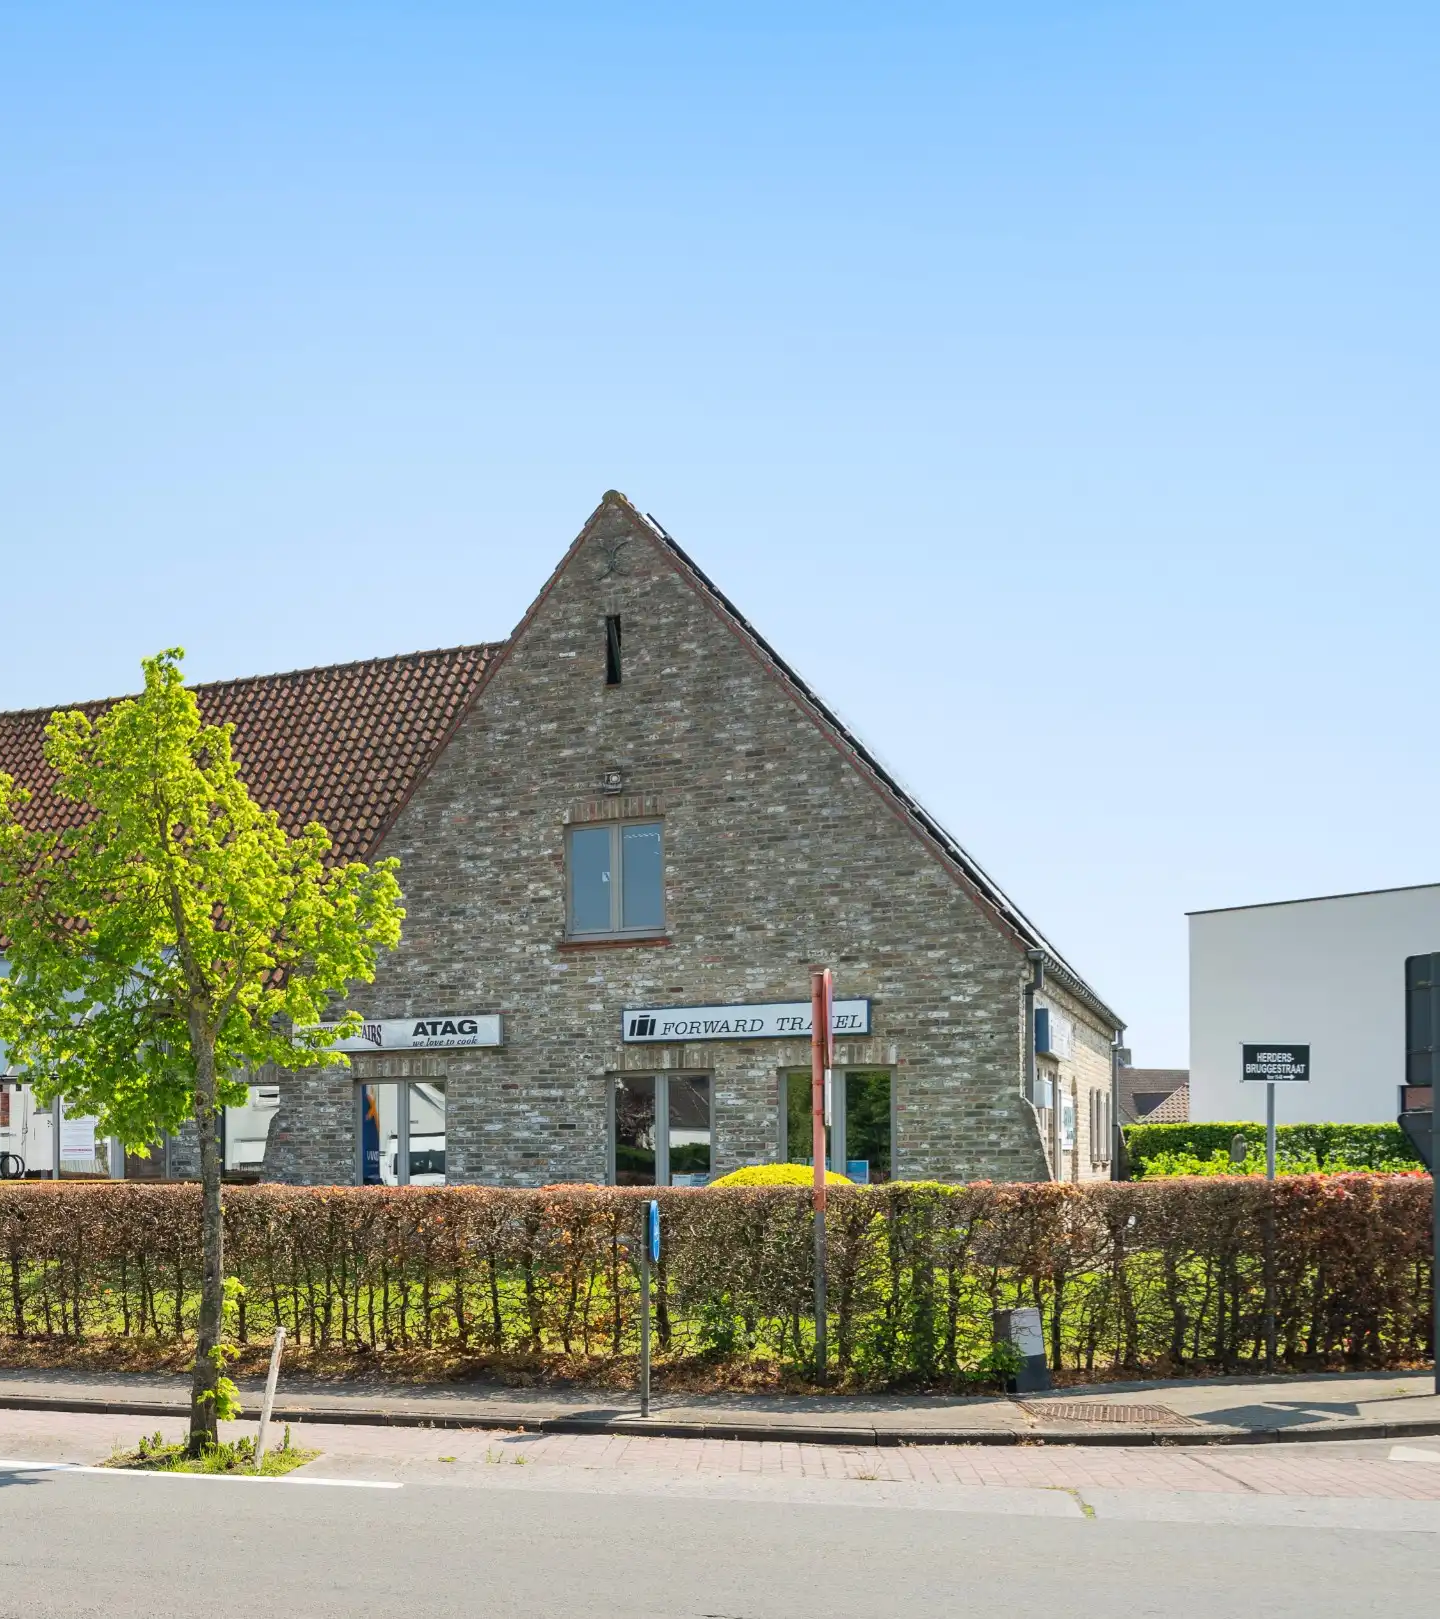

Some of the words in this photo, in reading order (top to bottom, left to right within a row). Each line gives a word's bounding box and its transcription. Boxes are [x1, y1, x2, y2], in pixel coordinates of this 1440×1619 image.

[412, 1020, 478, 1037] ATAG
[660, 1018, 764, 1036] FORWARD
[776, 1014, 862, 1031] TREL
[426, 1038, 444, 1047] love
[456, 1036, 478, 1045] cook
[1256, 1052, 1295, 1063] HERDERS-
[1245, 1063, 1306, 1074] BRUGGESTRAAT
